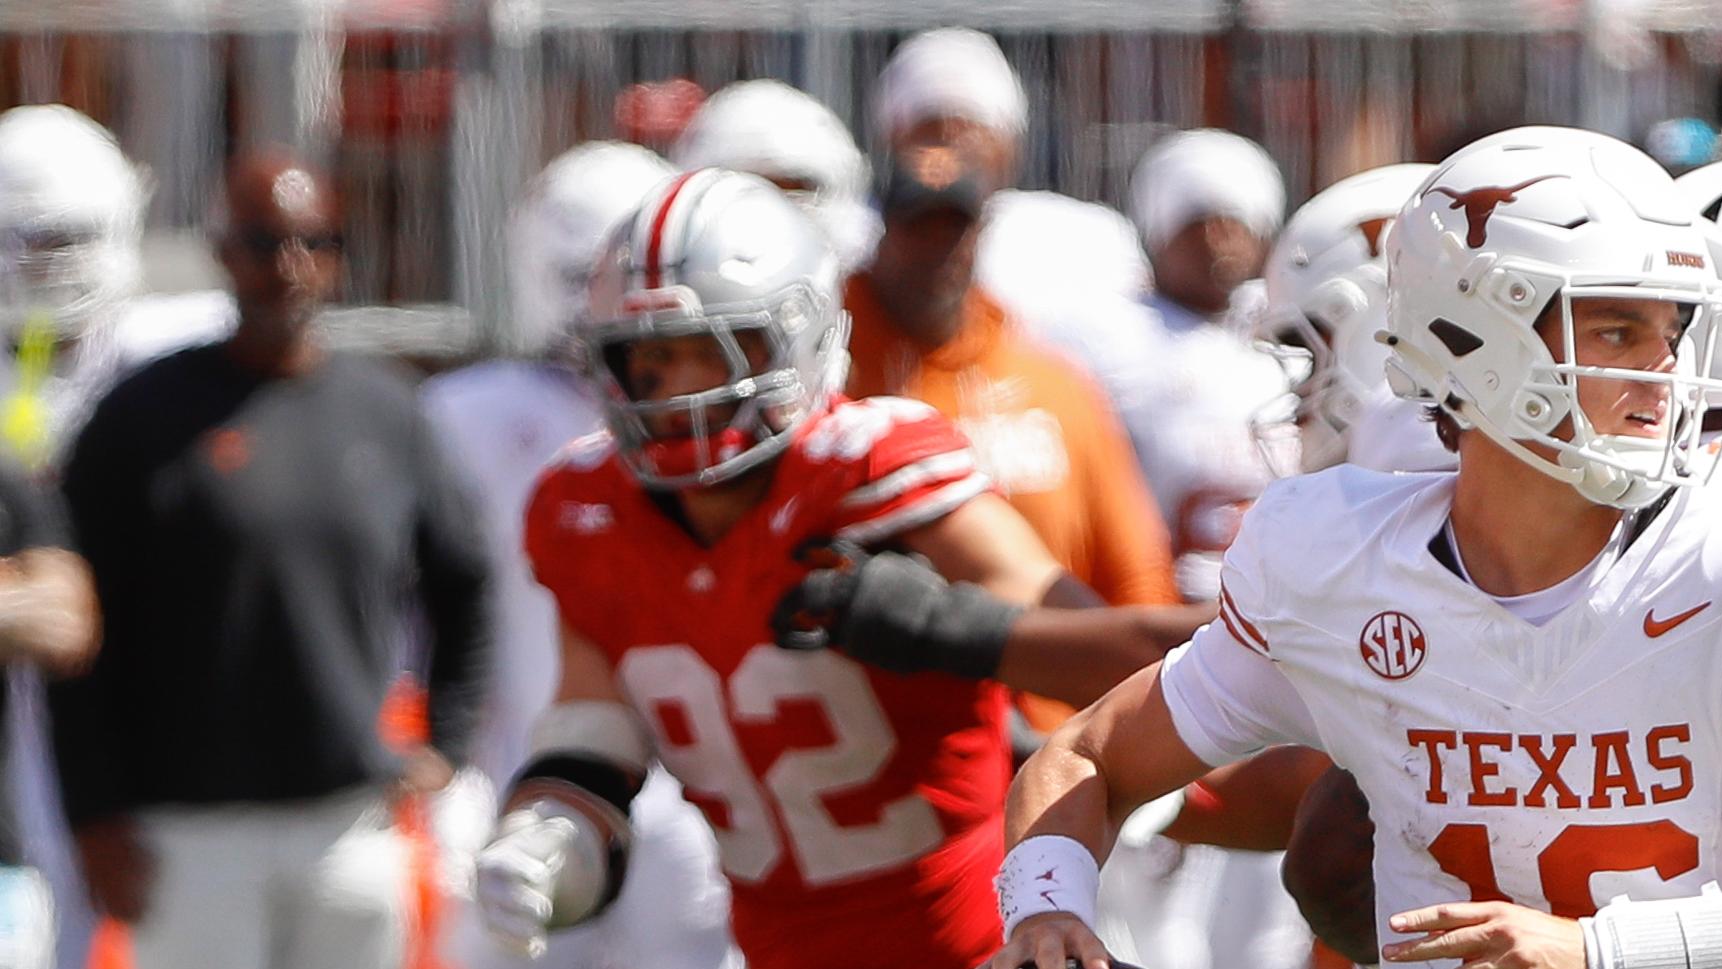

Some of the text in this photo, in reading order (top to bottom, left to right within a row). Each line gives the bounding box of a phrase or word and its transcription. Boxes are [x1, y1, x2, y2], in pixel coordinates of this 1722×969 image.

[1361, 612, 1425, 678] SEC
[618, 644, 945, 885] 92
[1407, 723, 1694, 809] TEXAS
